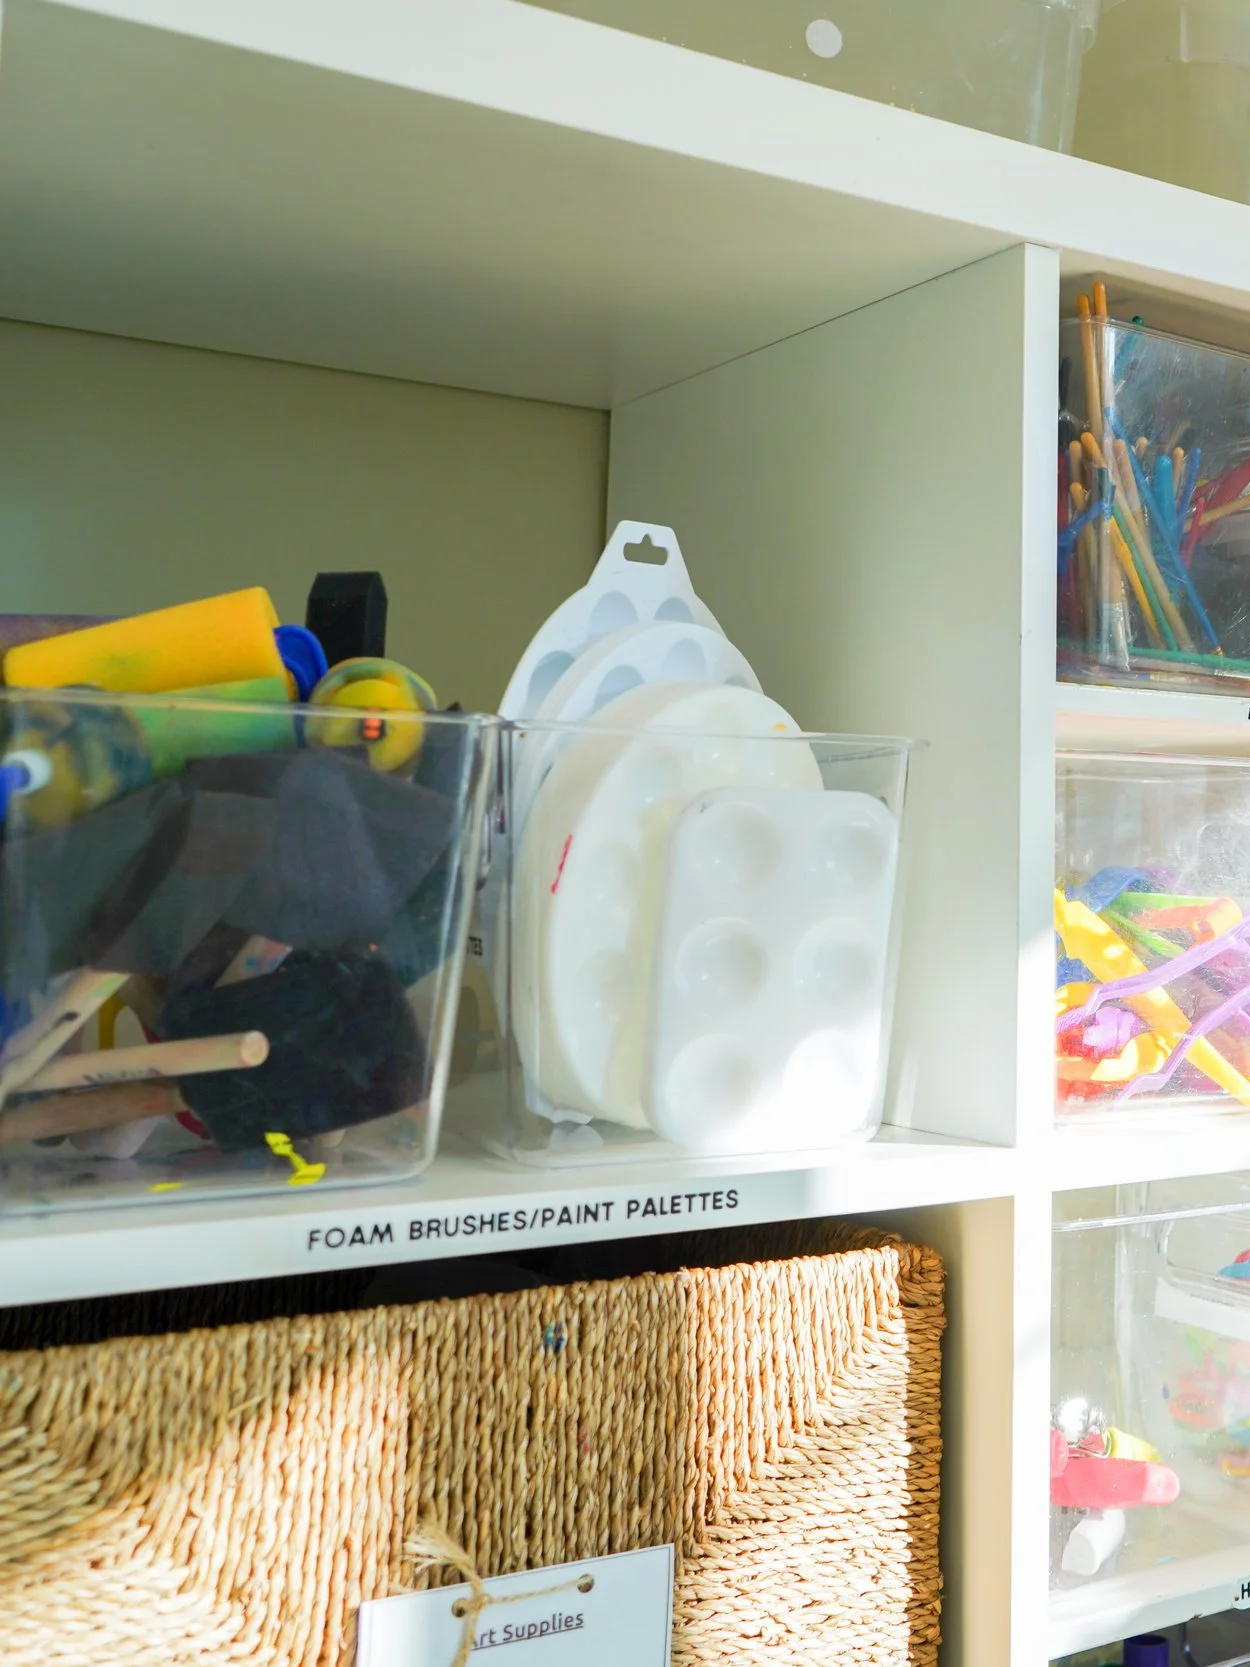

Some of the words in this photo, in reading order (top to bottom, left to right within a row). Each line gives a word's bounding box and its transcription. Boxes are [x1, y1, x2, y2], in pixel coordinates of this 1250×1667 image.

[307, 1222, 395, 1251] FOAM
[408, 1201, 616, 1241] BRUSHES/PAINT
[626, 1189, 740, 1220] PALETTES
[502, 1612, 584, 1641] Supplies
